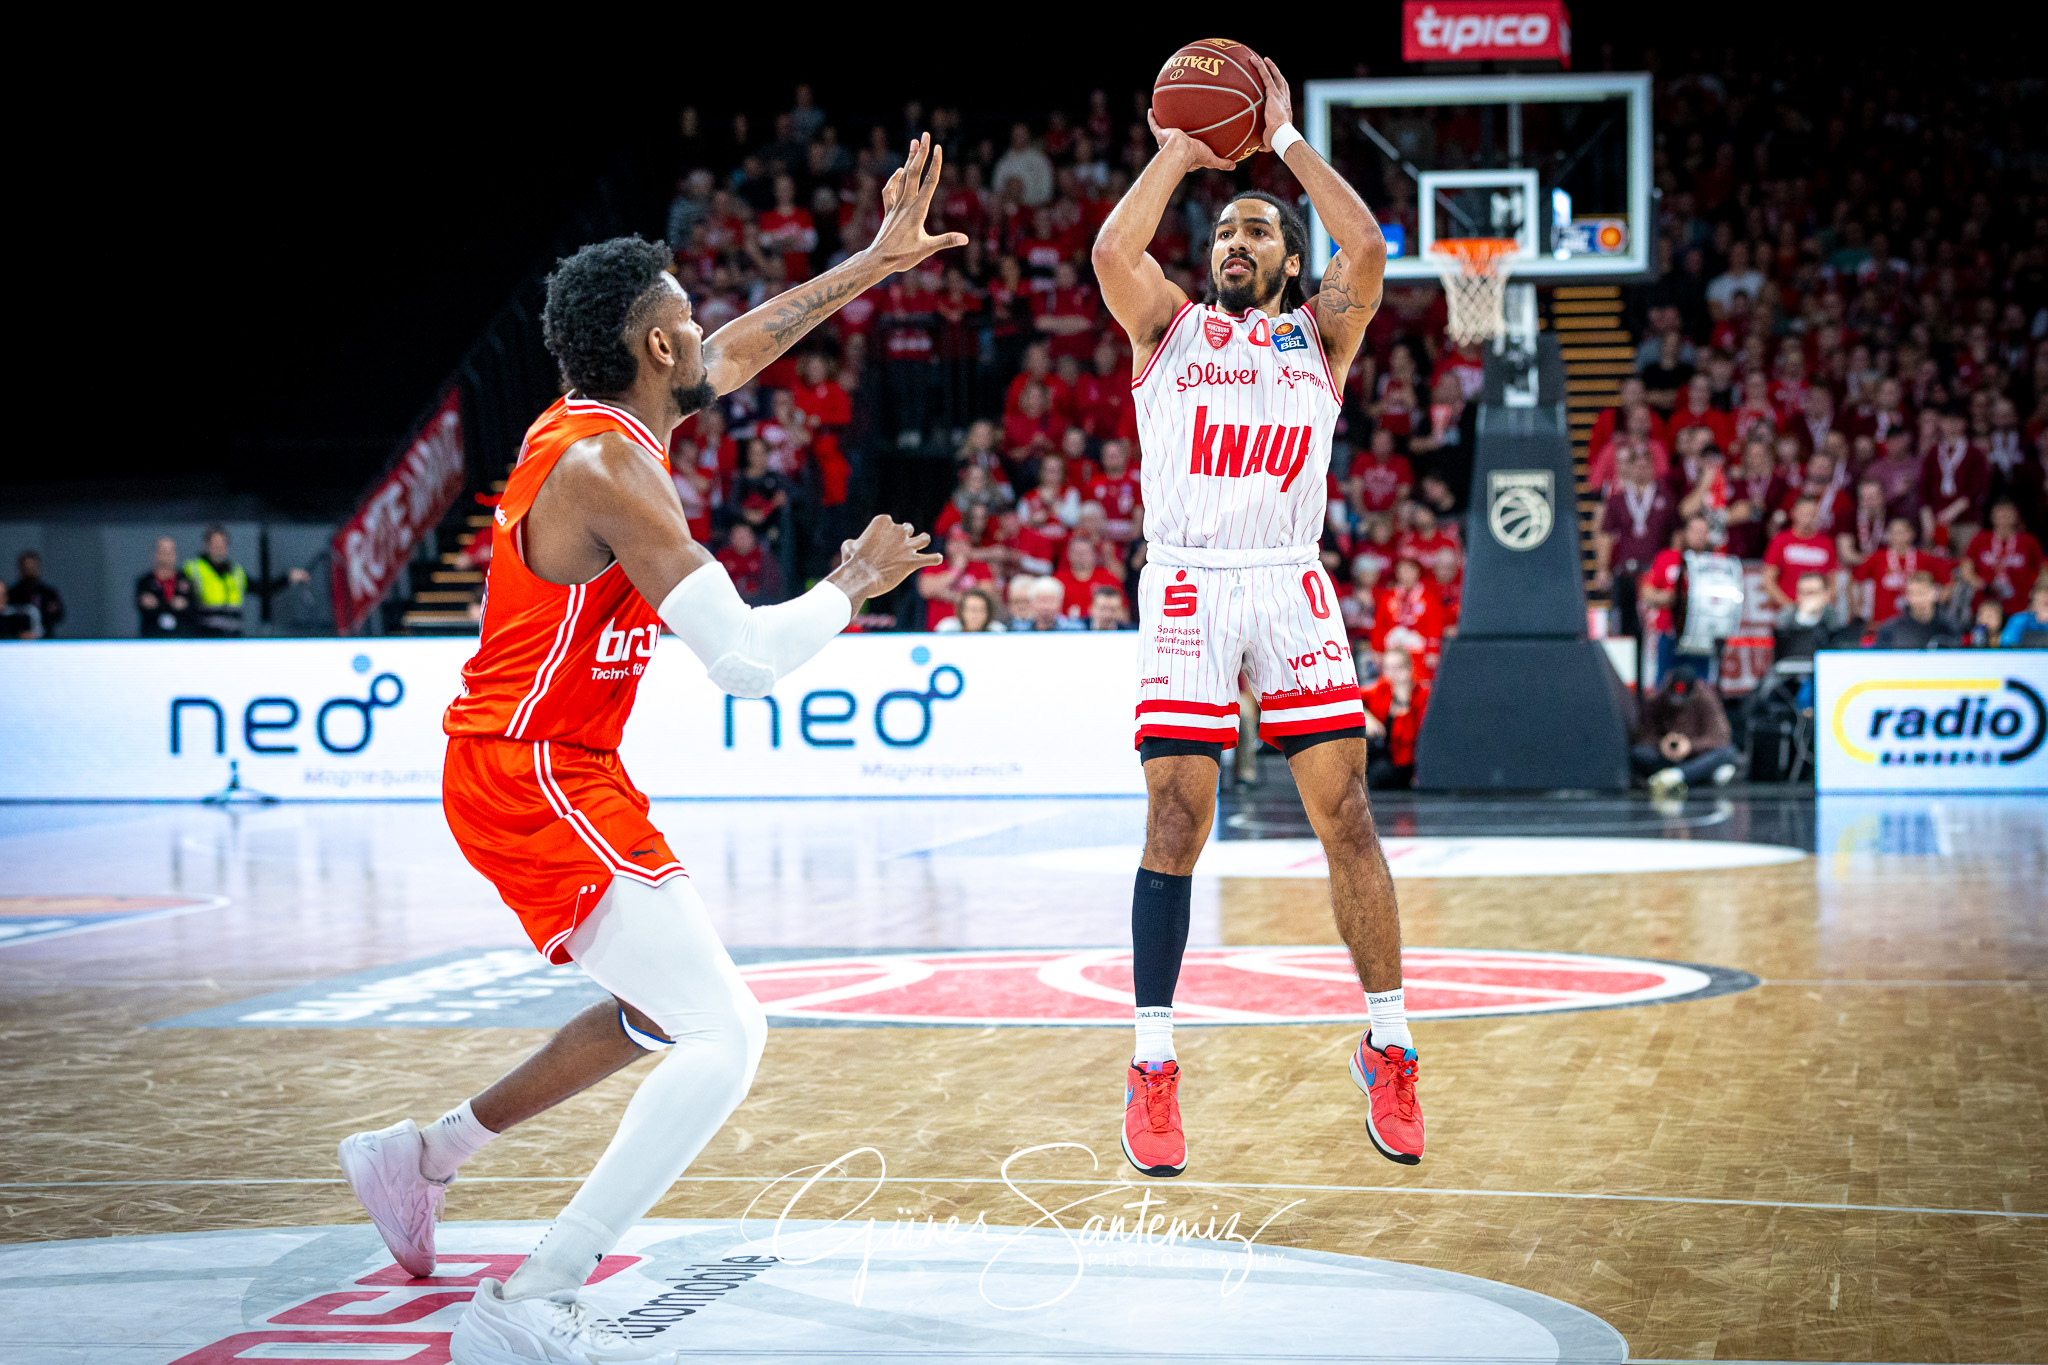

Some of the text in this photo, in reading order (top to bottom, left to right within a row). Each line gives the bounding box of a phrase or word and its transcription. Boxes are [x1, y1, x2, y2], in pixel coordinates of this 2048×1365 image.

[1414, 5, 1550, 54] tipico
[1280, 340, 1305, 350] BBL
[1302, 570, 1330, 619] 0
[595, 616, 661, 663] bro
[1156, 646, 1201, 659] Würzburg
[1157, 624, 1201, 636] Sparkasse
[169, 672, 404, 754] neo
[724, 664, 964, 749] neo
[1869, 696, 2023, 738] radio
[595, 1255, 784, 1339] utomobile
